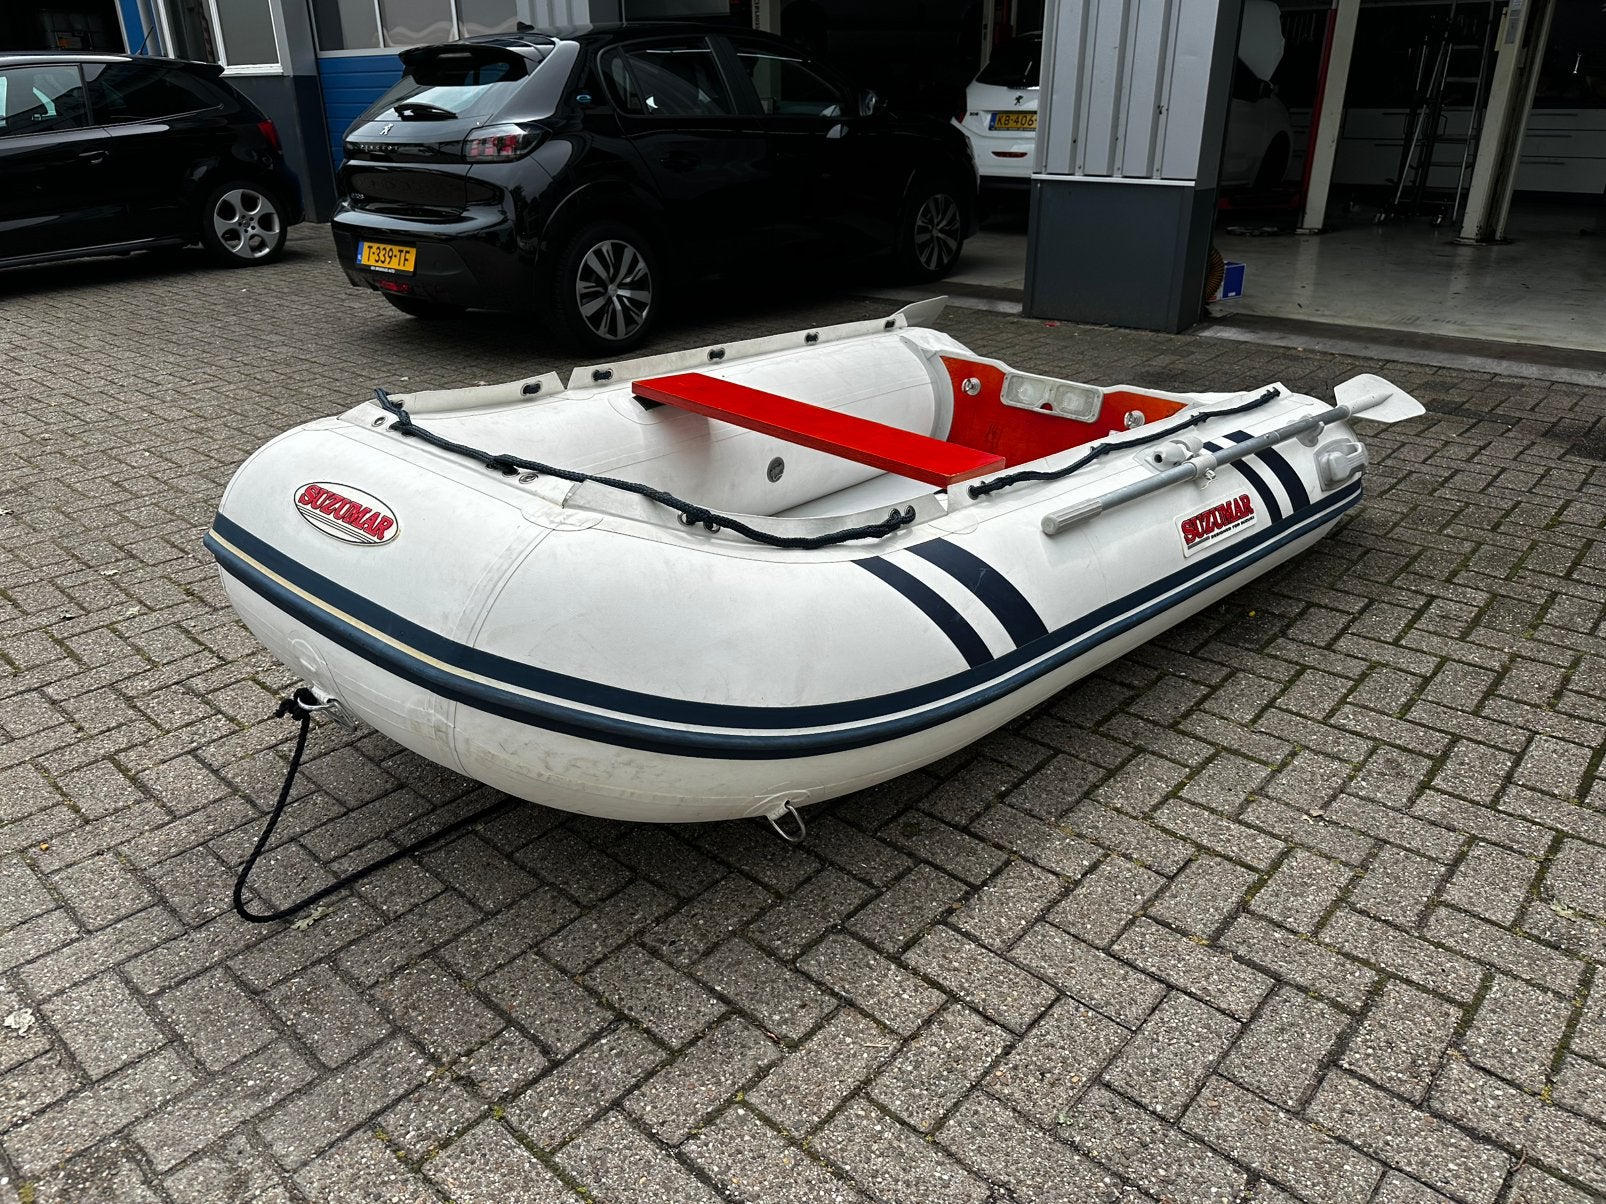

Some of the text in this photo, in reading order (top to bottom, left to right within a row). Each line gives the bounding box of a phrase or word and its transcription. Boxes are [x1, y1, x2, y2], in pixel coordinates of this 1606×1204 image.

[367, 245, 411, 267] T-339-TF
[298, 484, 395, 541] SUZUMAR
[1181, 493, 1255, 546] SUZUMAR
